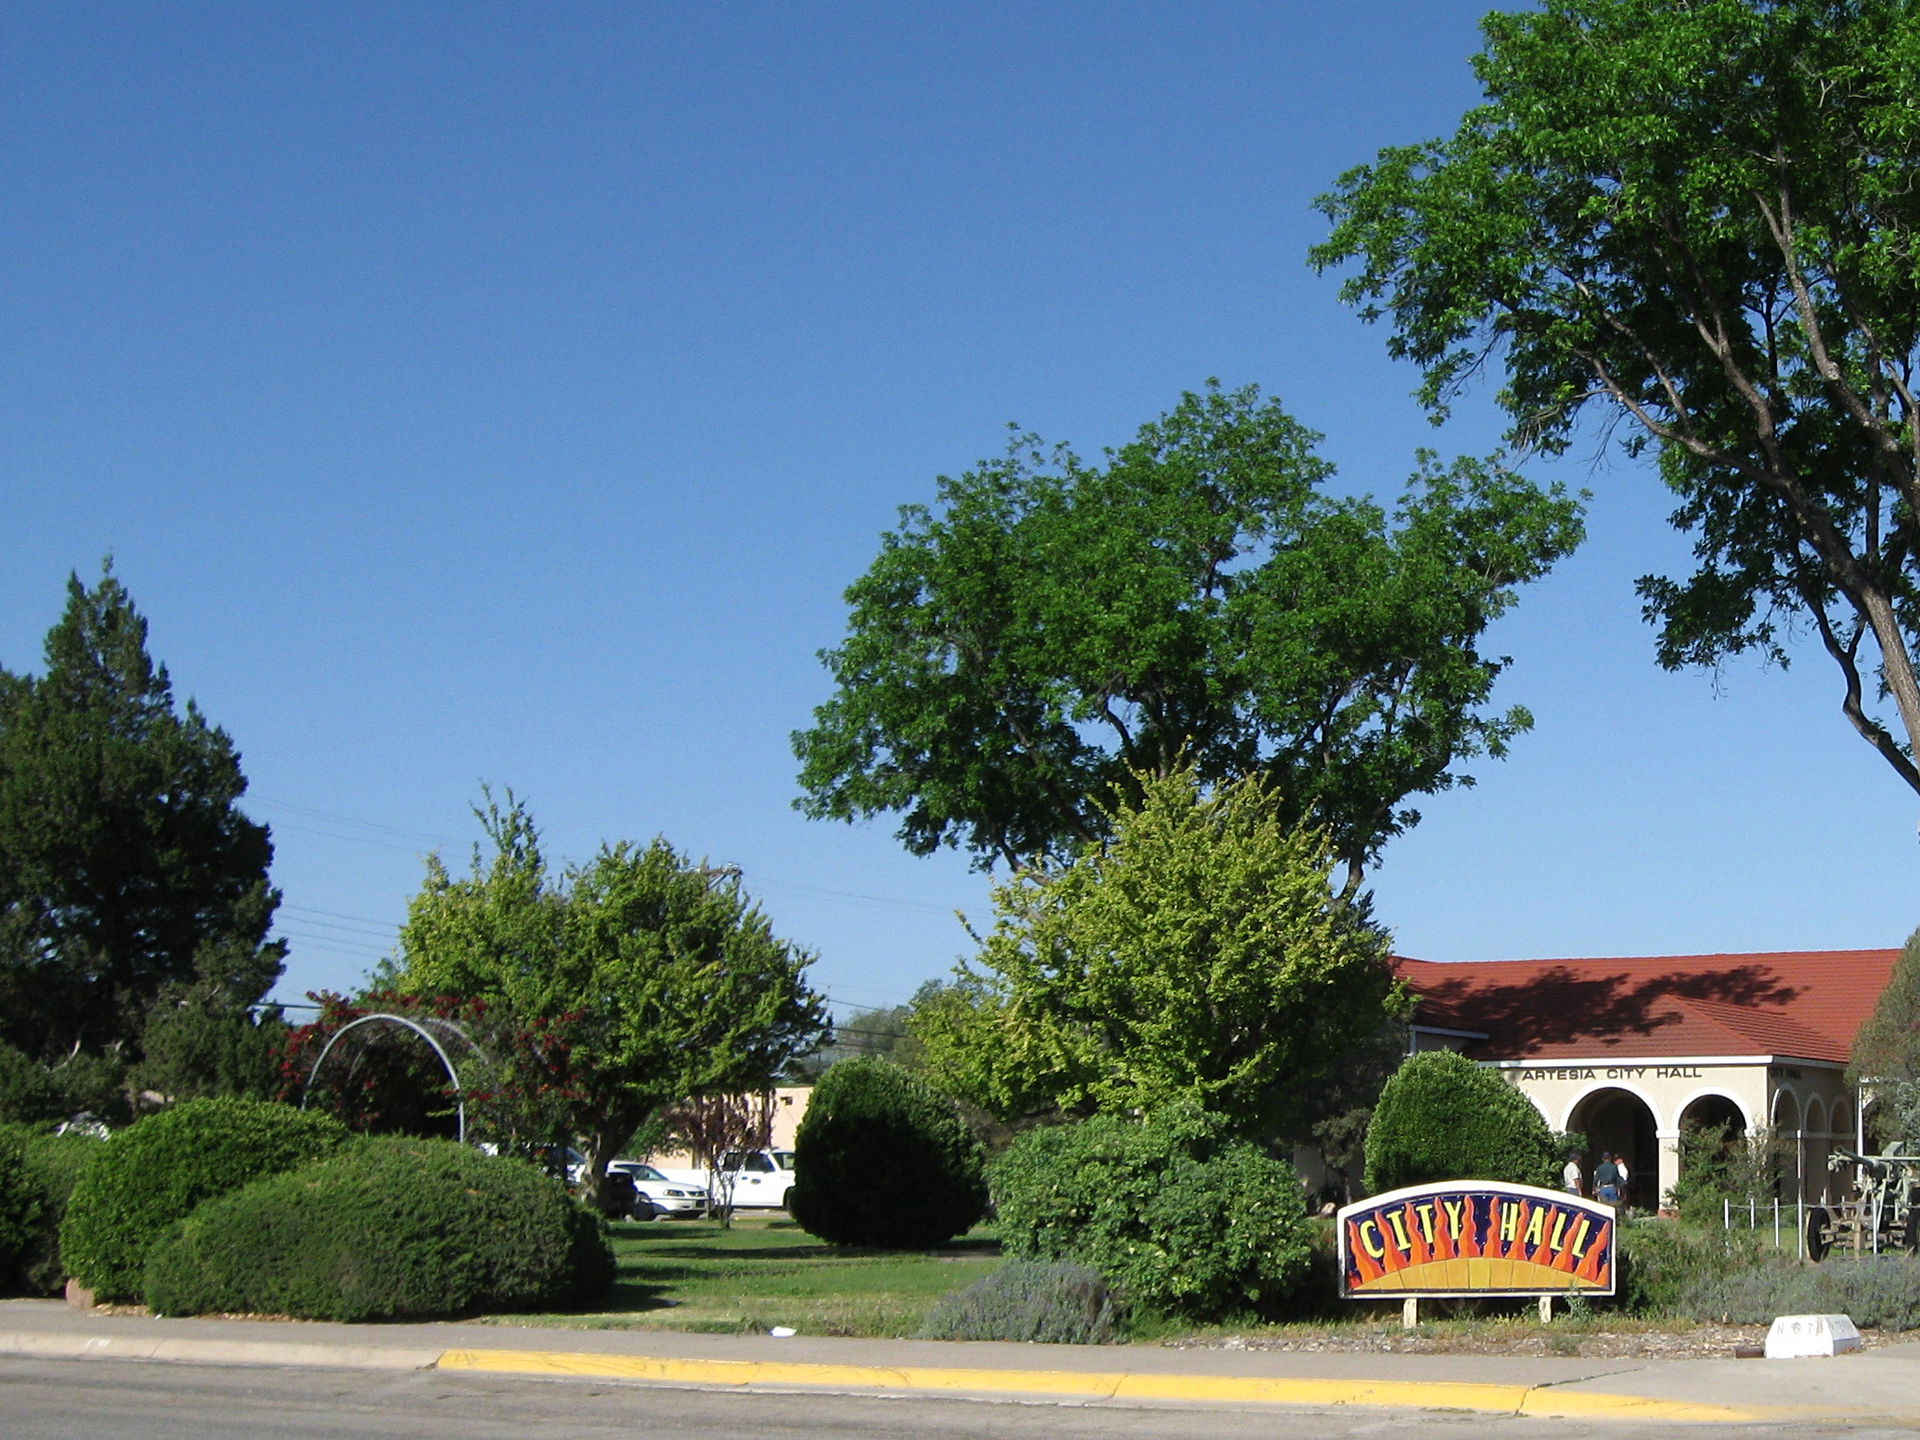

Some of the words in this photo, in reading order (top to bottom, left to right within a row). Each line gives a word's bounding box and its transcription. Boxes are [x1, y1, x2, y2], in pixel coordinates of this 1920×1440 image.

[1522, 1068, 1597, 1081] ARTESIA
[1606, 1067, 1647, 1080] CITY
[1656, 1066, 1703, 1079] HALL
[1359, 1201, 1463, 1259] CITY
[1500, 1202, 1592, 1259] HALL
